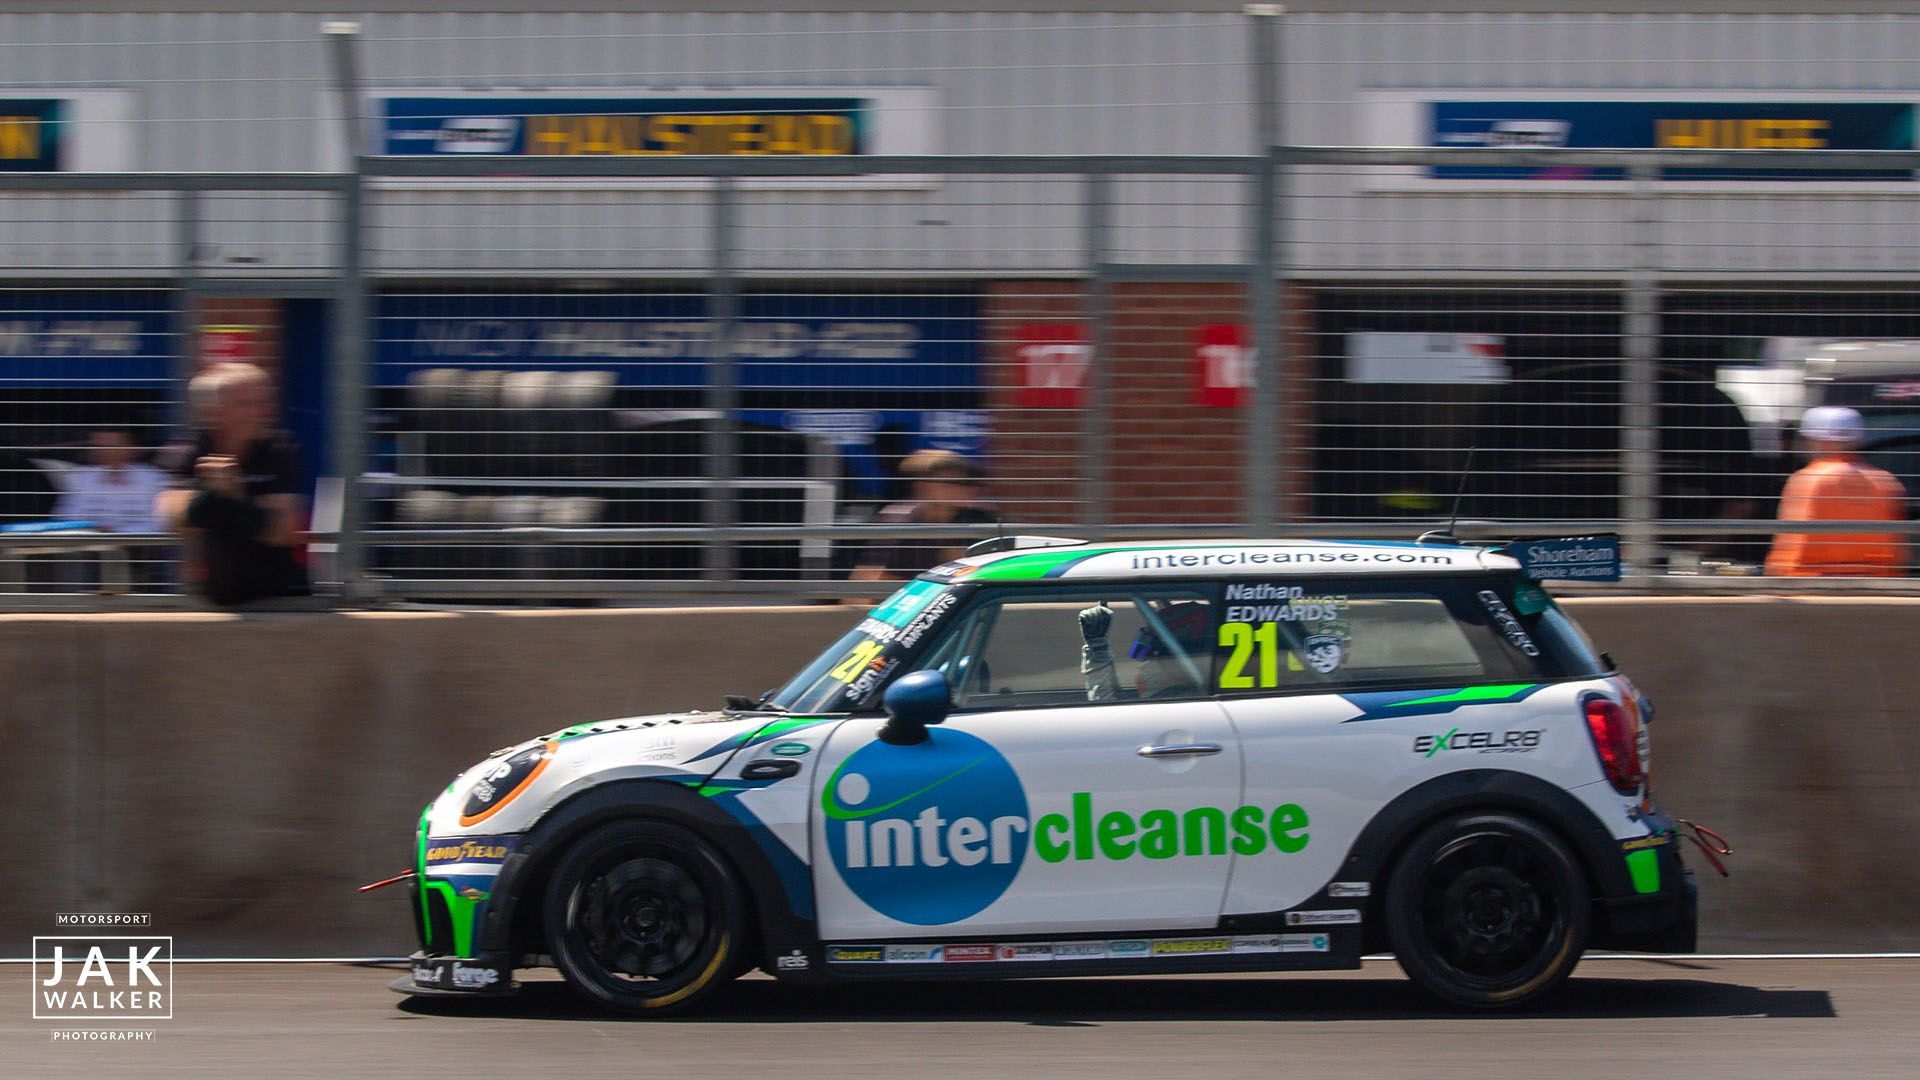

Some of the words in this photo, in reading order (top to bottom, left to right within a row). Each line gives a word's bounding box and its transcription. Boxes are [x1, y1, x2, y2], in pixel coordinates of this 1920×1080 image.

[1132, 551, 1453, 569] intercleanse.com
[1527, 545, 1615, 563] Shoreham
[1529, 567, 1568, 578] Vehicle
[1569, 566, 1615, 577] Auctions
[1225, 583, 1304, 600] Nathan
[1225, 605, 1338, 622] EDWARDS
[830, 640, 885, 684] 21
[1218, 622, 1279, 689] 21
[1413, 728, 1542, 758] EXCELR8
[427, 841, 508, 861] GOODYEAR
